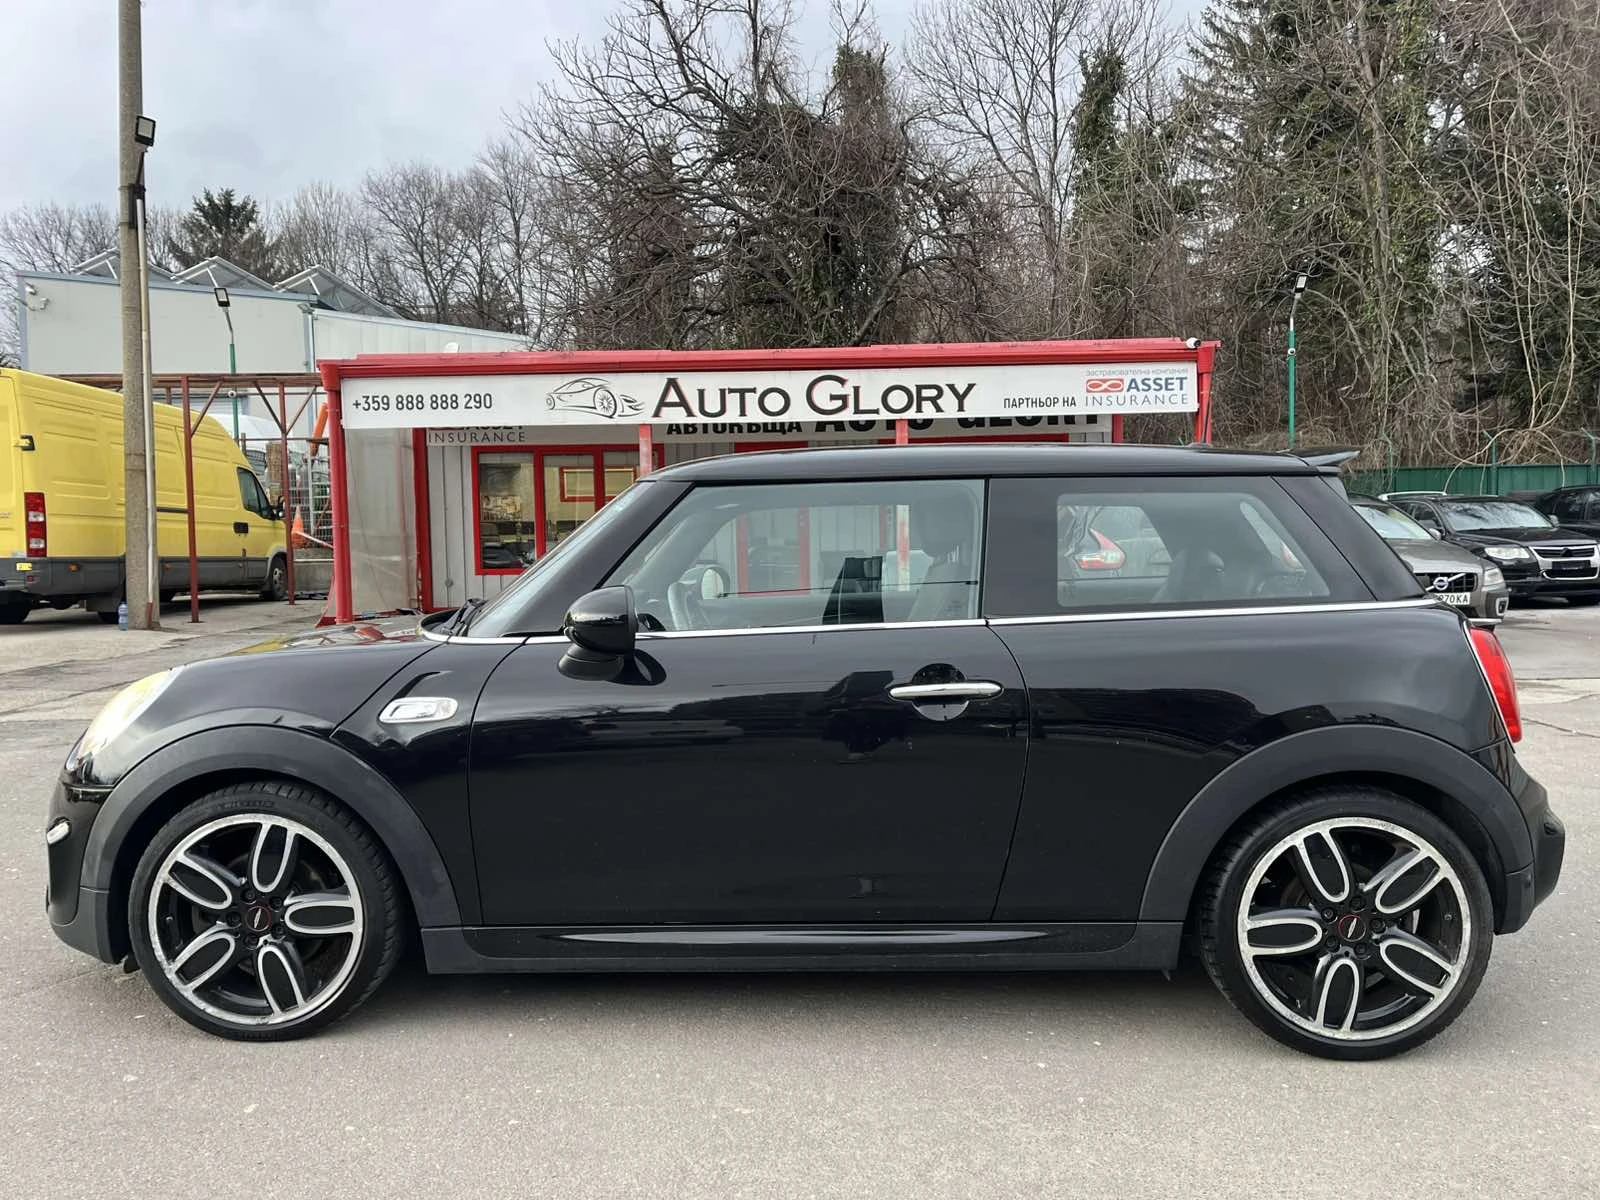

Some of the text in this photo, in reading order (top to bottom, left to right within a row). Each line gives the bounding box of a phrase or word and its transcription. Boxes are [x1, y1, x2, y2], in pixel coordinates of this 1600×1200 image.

[1126, 376, 1188, 393] ASSET
[352, 392, 493, 411] +359 888 888 290
[1003, 396, 1077, 408] ПАРТНЬОР НА
[1085, 393, 1189, 407] INSURANCE
[428, 431, 526, 443] INSURANCE
